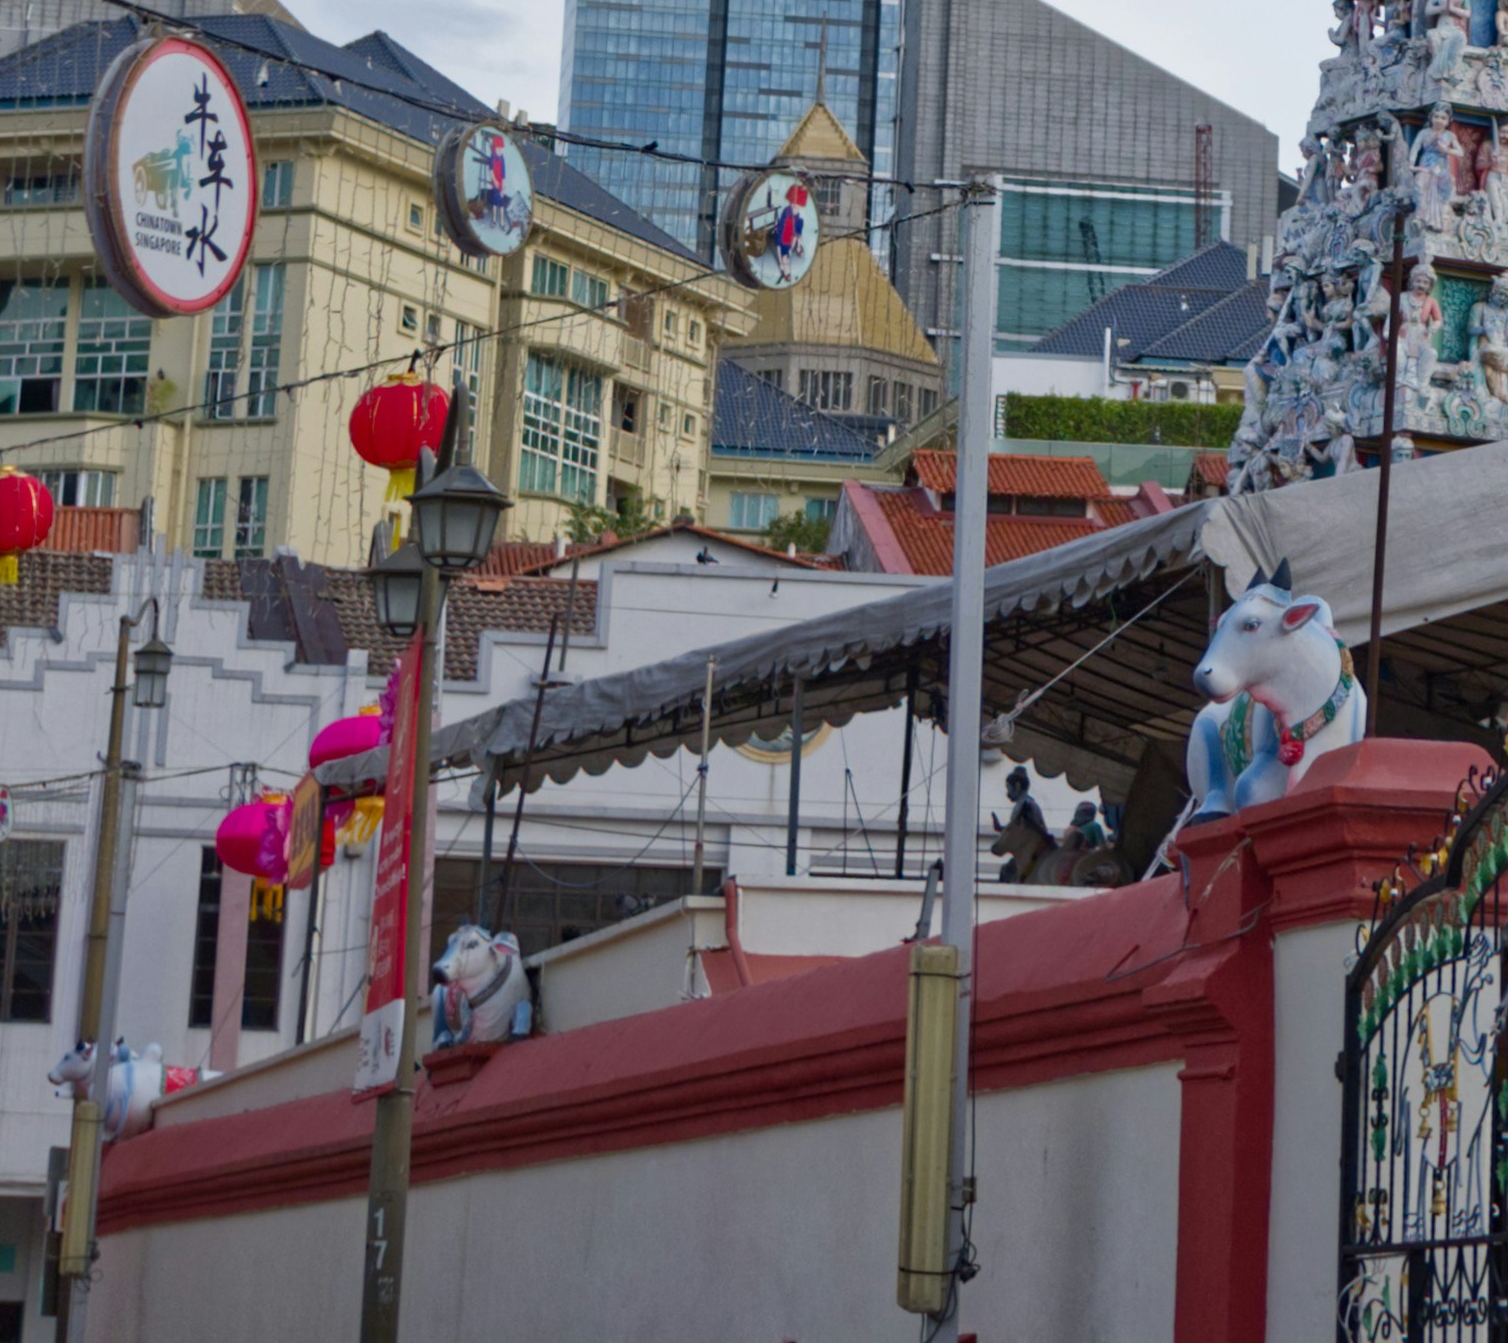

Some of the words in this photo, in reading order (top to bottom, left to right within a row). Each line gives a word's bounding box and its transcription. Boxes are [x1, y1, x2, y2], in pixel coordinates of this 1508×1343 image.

[184, 72, 233, 278] 牛车水
[136, 212, 182, 235] CHINATOWN
[135, 232, 181, 256] SINGAPORE
